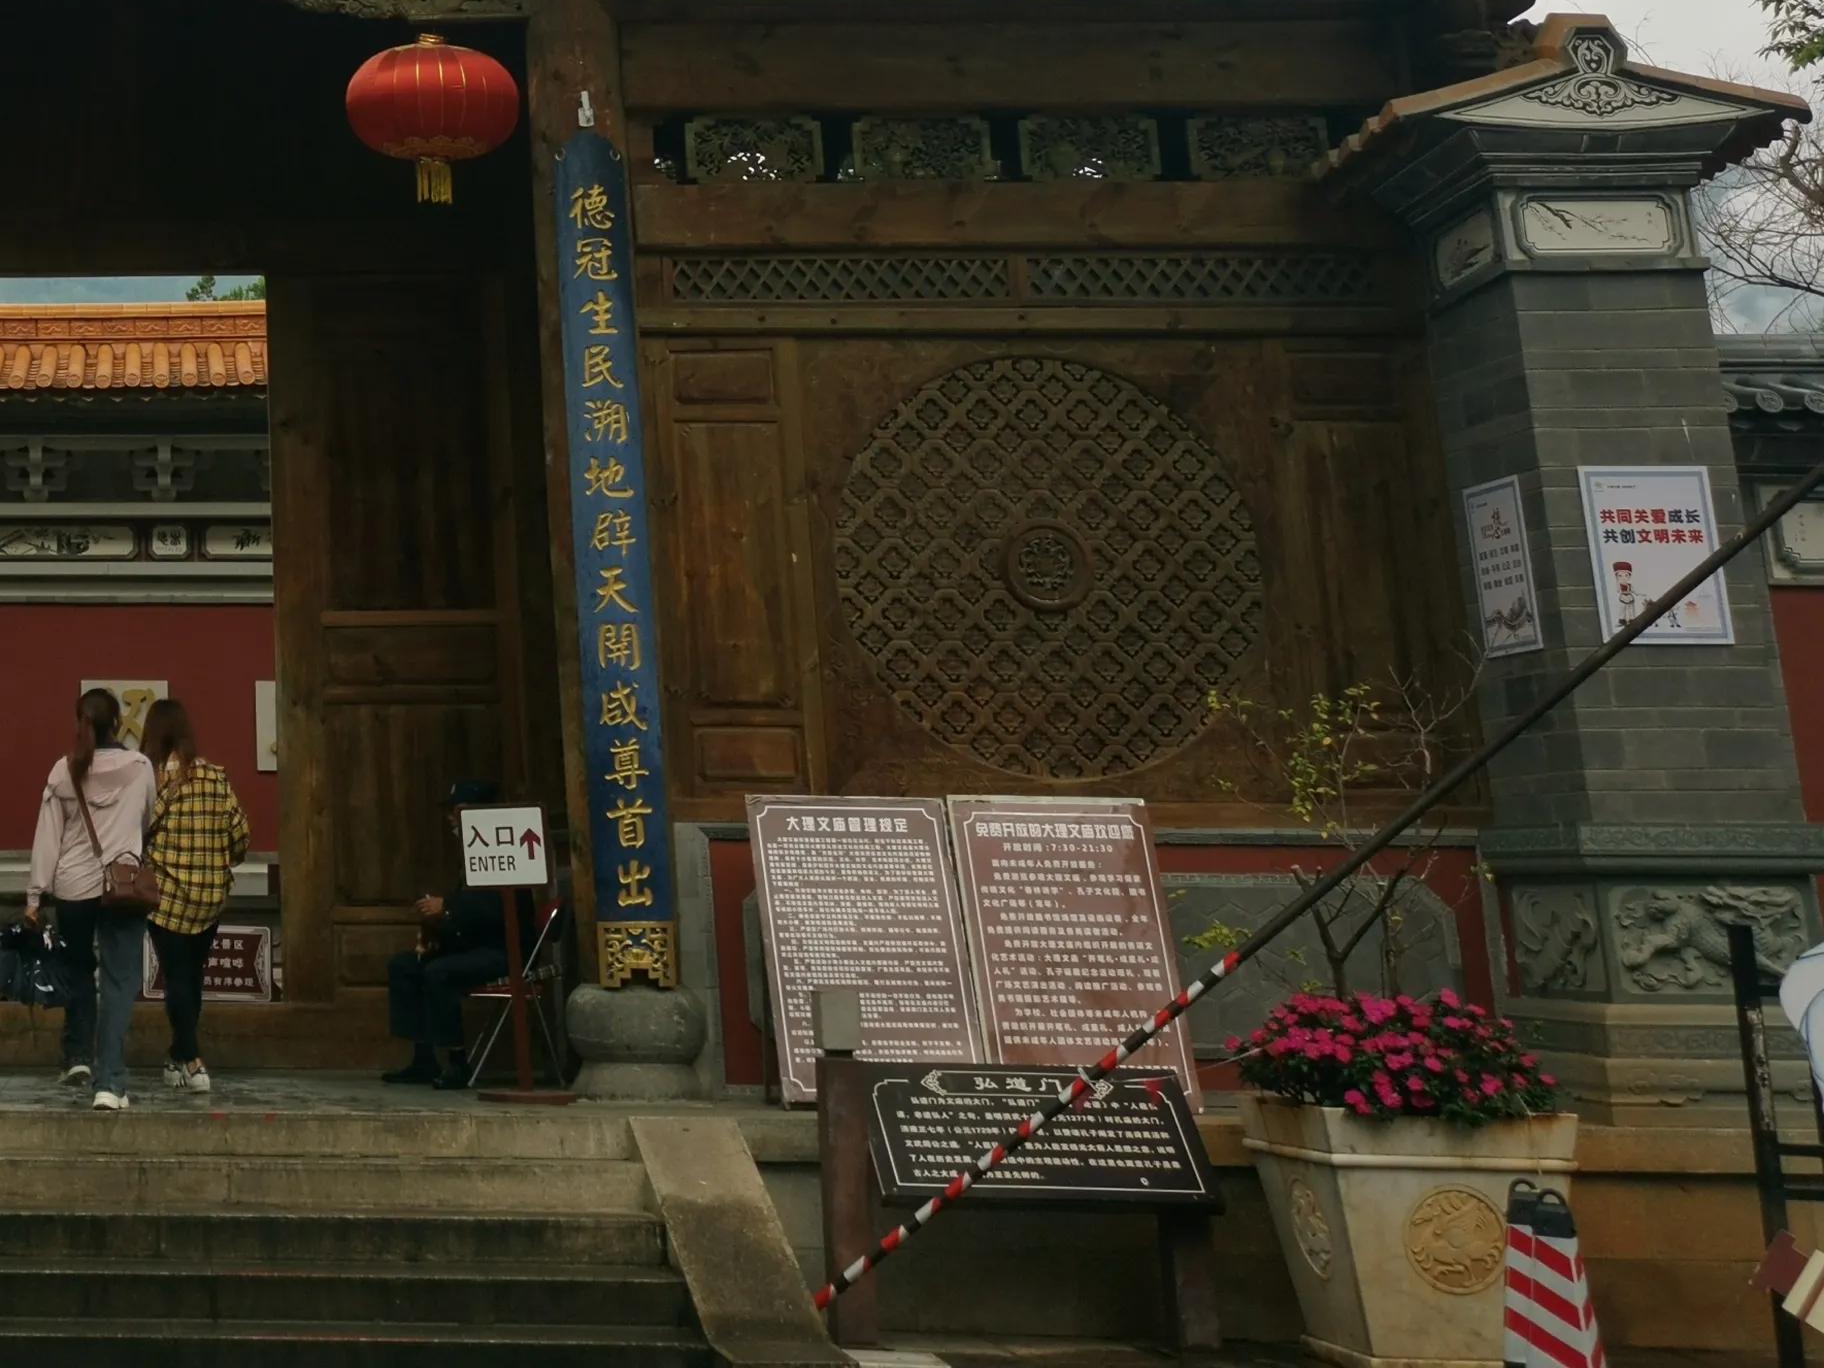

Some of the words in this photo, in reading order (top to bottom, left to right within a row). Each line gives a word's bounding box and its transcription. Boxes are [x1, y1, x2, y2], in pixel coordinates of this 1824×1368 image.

[1600, 508, 1701, 525] 共同关爱成长
[1603, 528, 1704, 544] 共创文明未来
[786, 816, 909, 833] 大理文庙管理规定
[975, 822, 1136, 840] 免费开放的大理文庙欢迎您
[467, 825, 515, 848] 入口
[469, 855, 517, 872] ENTER
[202, 957, 244, 969] 声喧哗
[974, 1075, 1063, 1093] 弘道门
